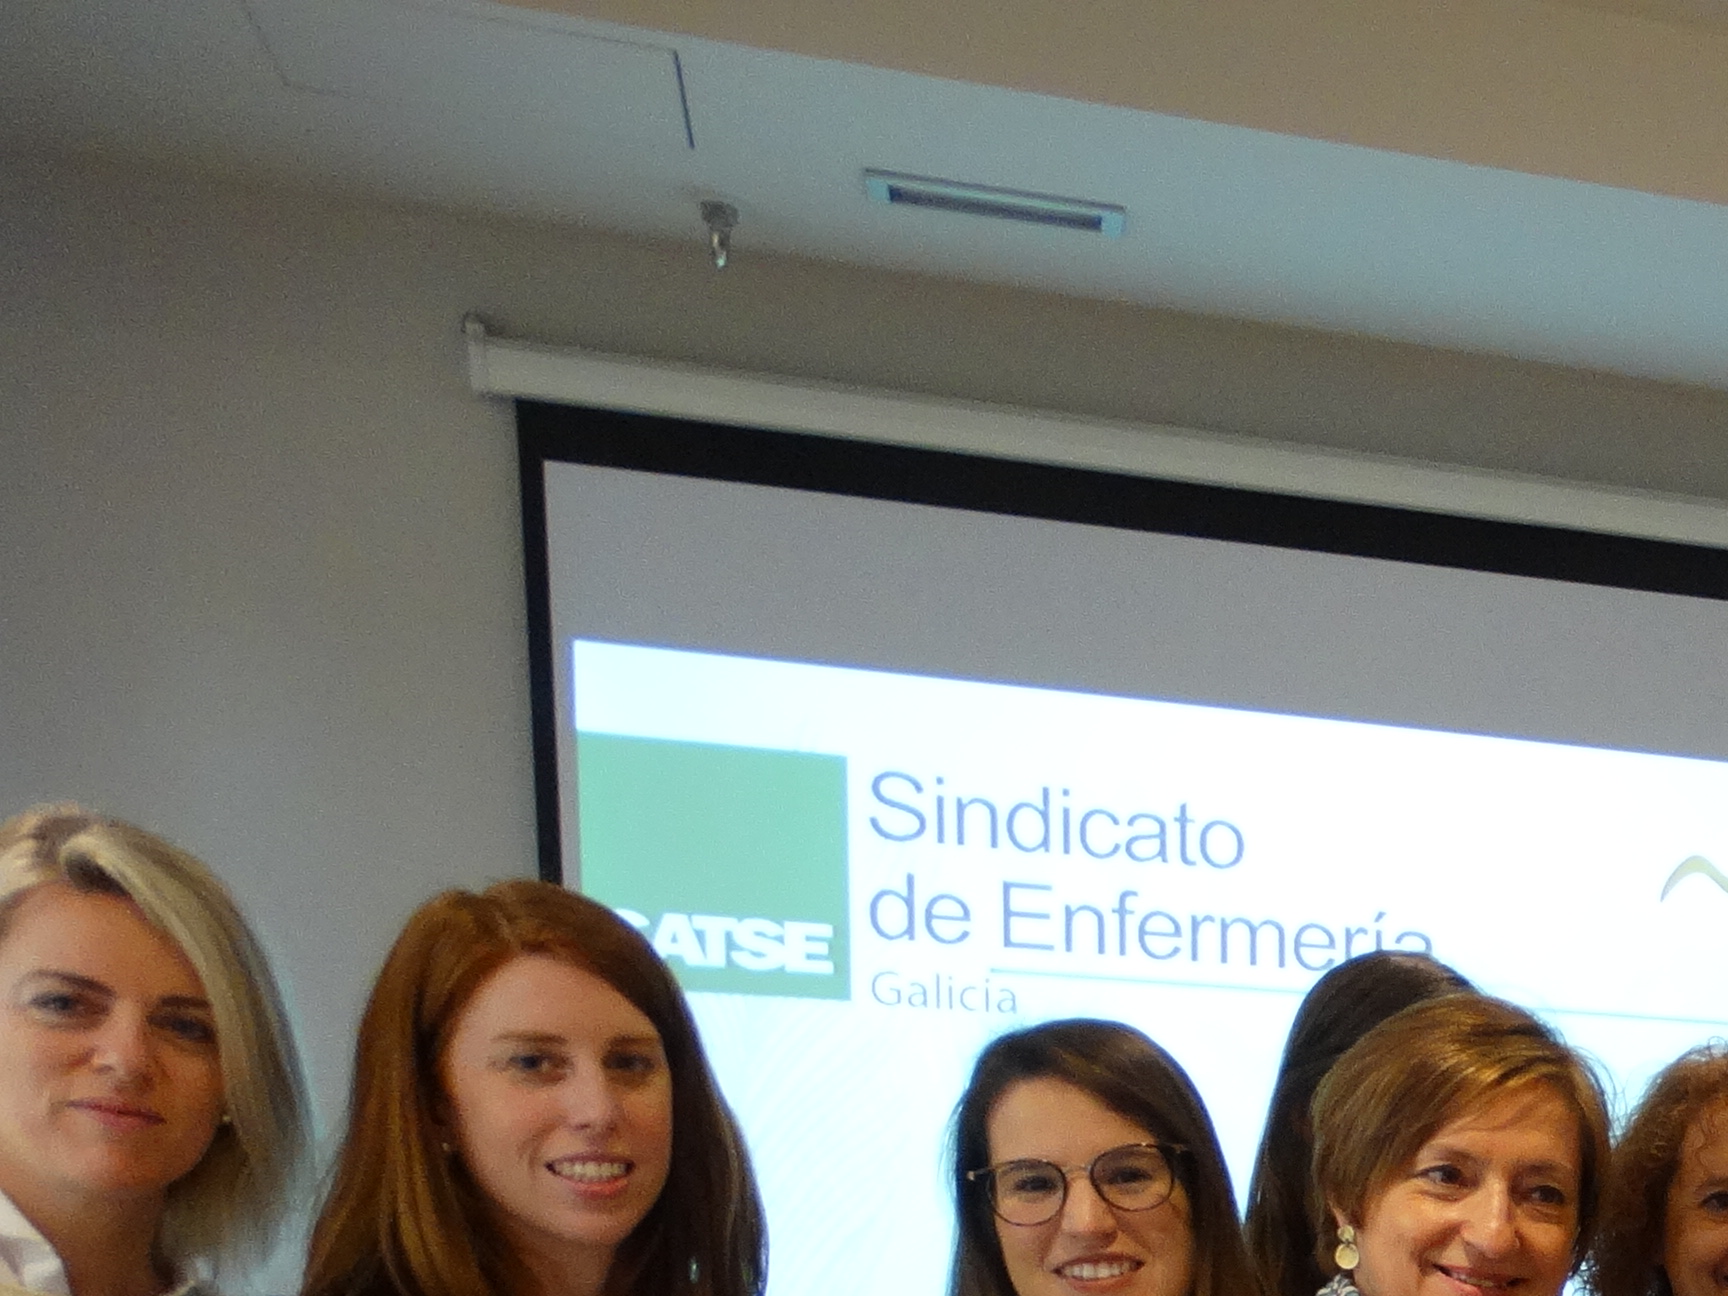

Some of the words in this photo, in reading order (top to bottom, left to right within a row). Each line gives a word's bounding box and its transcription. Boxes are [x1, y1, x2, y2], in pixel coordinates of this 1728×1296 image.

[869, 770, 1245, 870] Sindicato
[869, 872, 972, 945] de
[870, 970, 1018, 1015] Galicia
